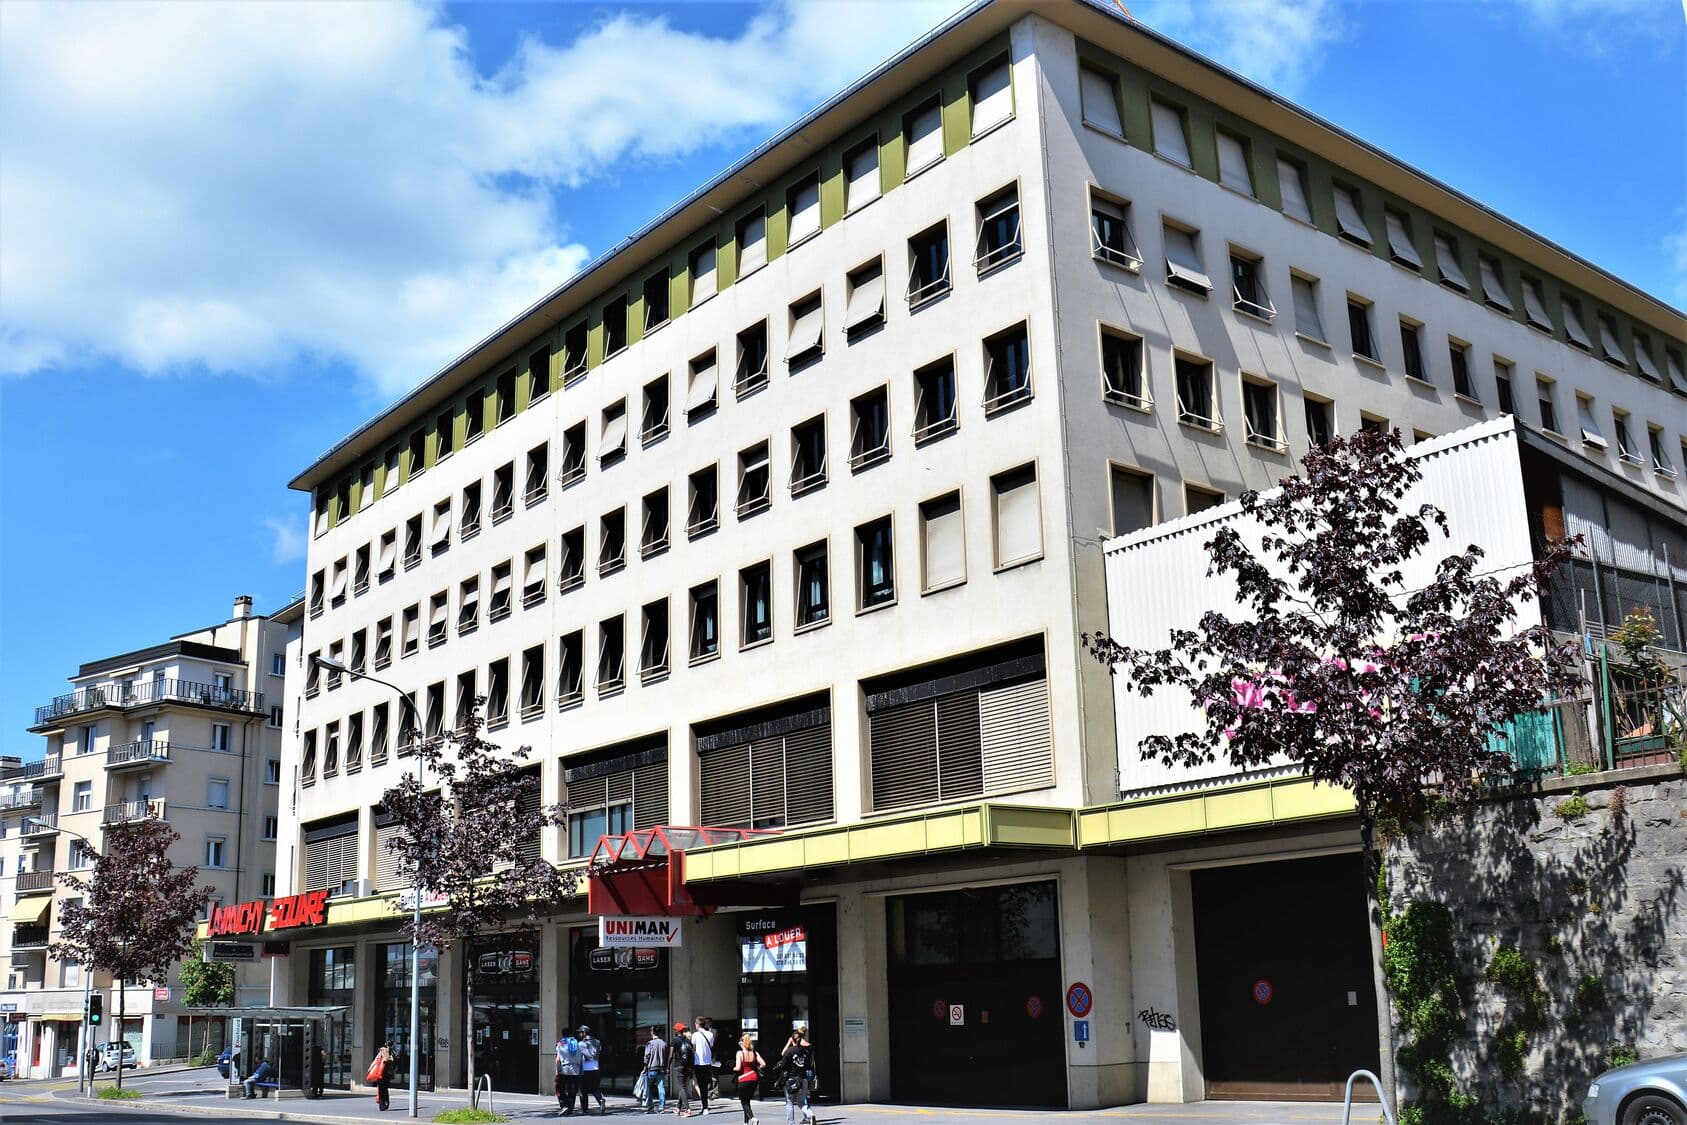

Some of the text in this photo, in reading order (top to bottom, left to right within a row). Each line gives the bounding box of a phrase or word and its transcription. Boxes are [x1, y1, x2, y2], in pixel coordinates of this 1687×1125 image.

[401, 893, 424, 906] Surfae
[269, 890, 328, 929] SQUARE
[605, 920, 670, 935] UNIMAN
[745, 919, 776, 930] Surface
[773, 927, 801, 945] LOUER
[592, 954, 655, 964] LASER GAME
